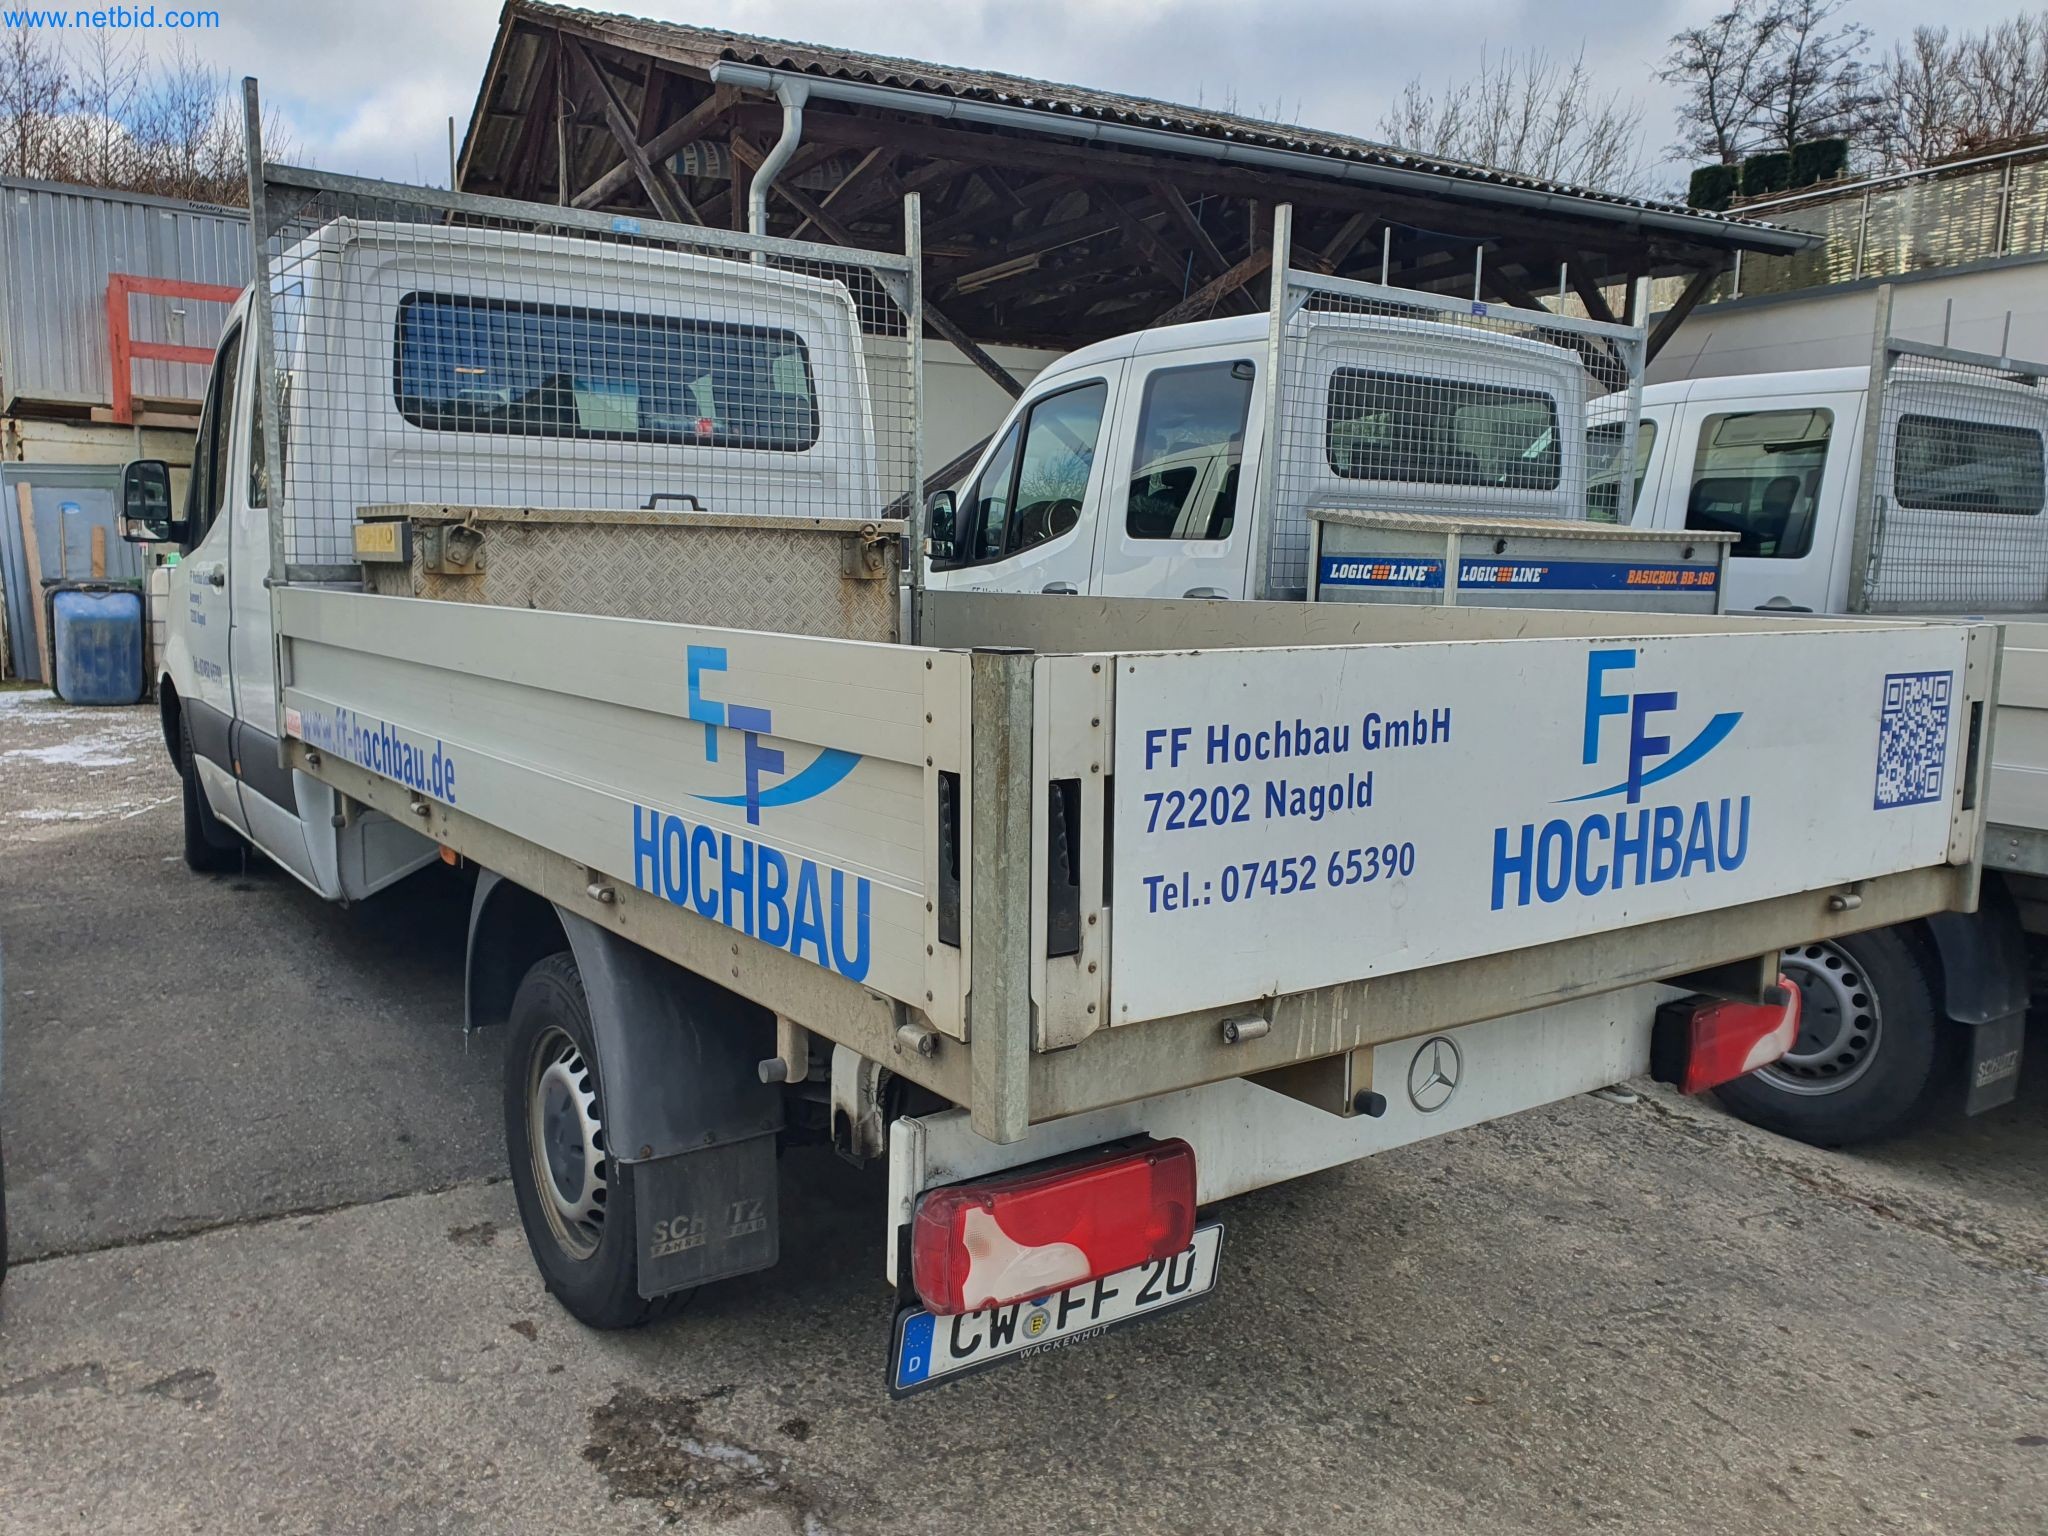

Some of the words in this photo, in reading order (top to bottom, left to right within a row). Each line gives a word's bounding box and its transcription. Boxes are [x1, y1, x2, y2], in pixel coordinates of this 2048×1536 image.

[1330, 563, 1372, 579] LOGIC
[1388, 565, 1428, 582] LINE
[1460, 566, 1497, 582] LOGIC
[1511, 567, 1542, 583] LINE
[1626, 569, 1678, 585] BASICBOX
[1680, 571, 1715, 586] BB-160
[686, 645, 785, 826] FF
[1145, 727, 1192, 770] FF
[1206, 714, 1349, 765] Hochbau
[1362, 707, 1451, 750] GmbH
[1582, 649, 1678, 804] FF
[1144, 783, 1250, 833] 72202
[1265, 771, 1373, 821] Nagold
[1142, 871, 1211, 913] Tel.:
[1220, 855, 1317, 903] 07452
[1327, 842, 1415, 887] 65390
[1490, 795, 1751, 912] HOCHBAU
[633, 803, 870, 983] HOCHBAU
[949, 1304, 1020, 1359] CW
[1019, 1325, 1110, 1361] WACKENHUT
[907, 1355, 921, 1374] D
